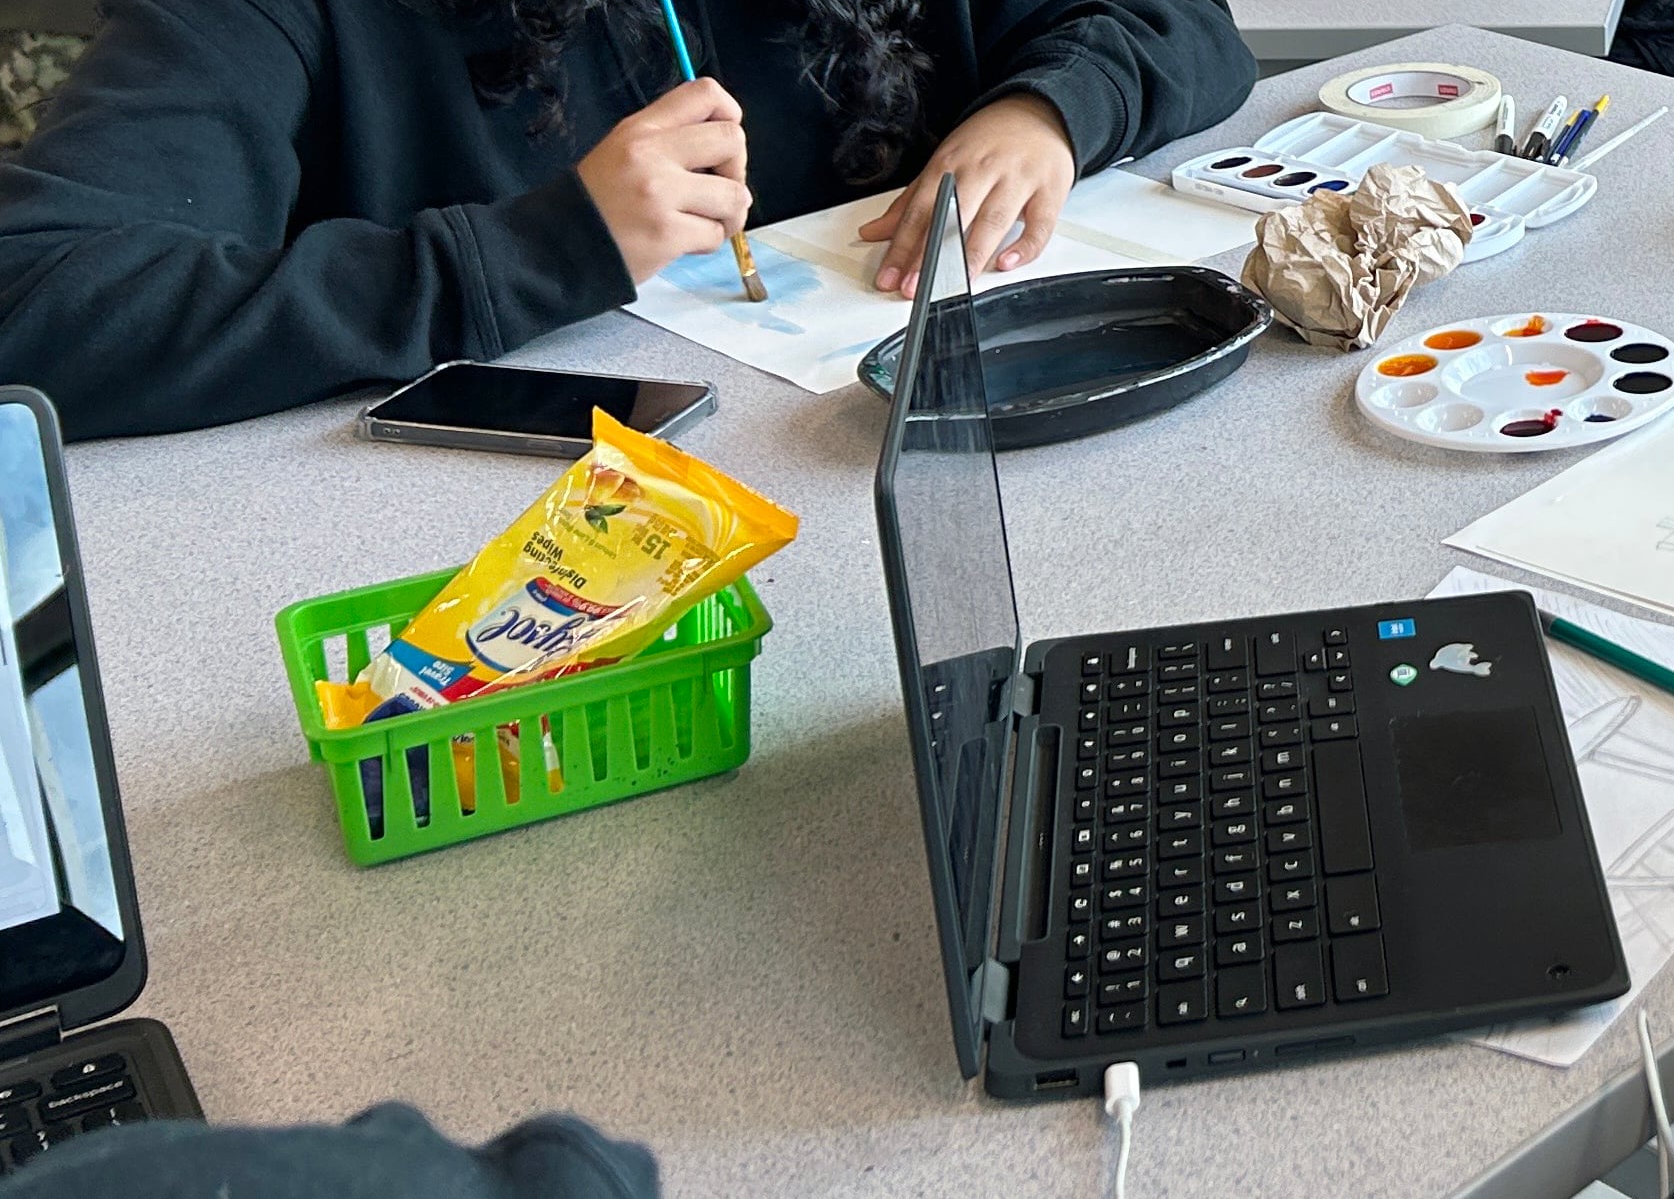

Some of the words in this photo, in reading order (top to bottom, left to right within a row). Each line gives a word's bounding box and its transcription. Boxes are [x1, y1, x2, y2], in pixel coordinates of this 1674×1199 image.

[531, 531, 563, 561] Wipes
[641, 533, 672, 561] 15
[523, 542, 587, 590] Disinfecting
[418, 665, 452, 686] Travel
[432, 660, 455, 675] Size
